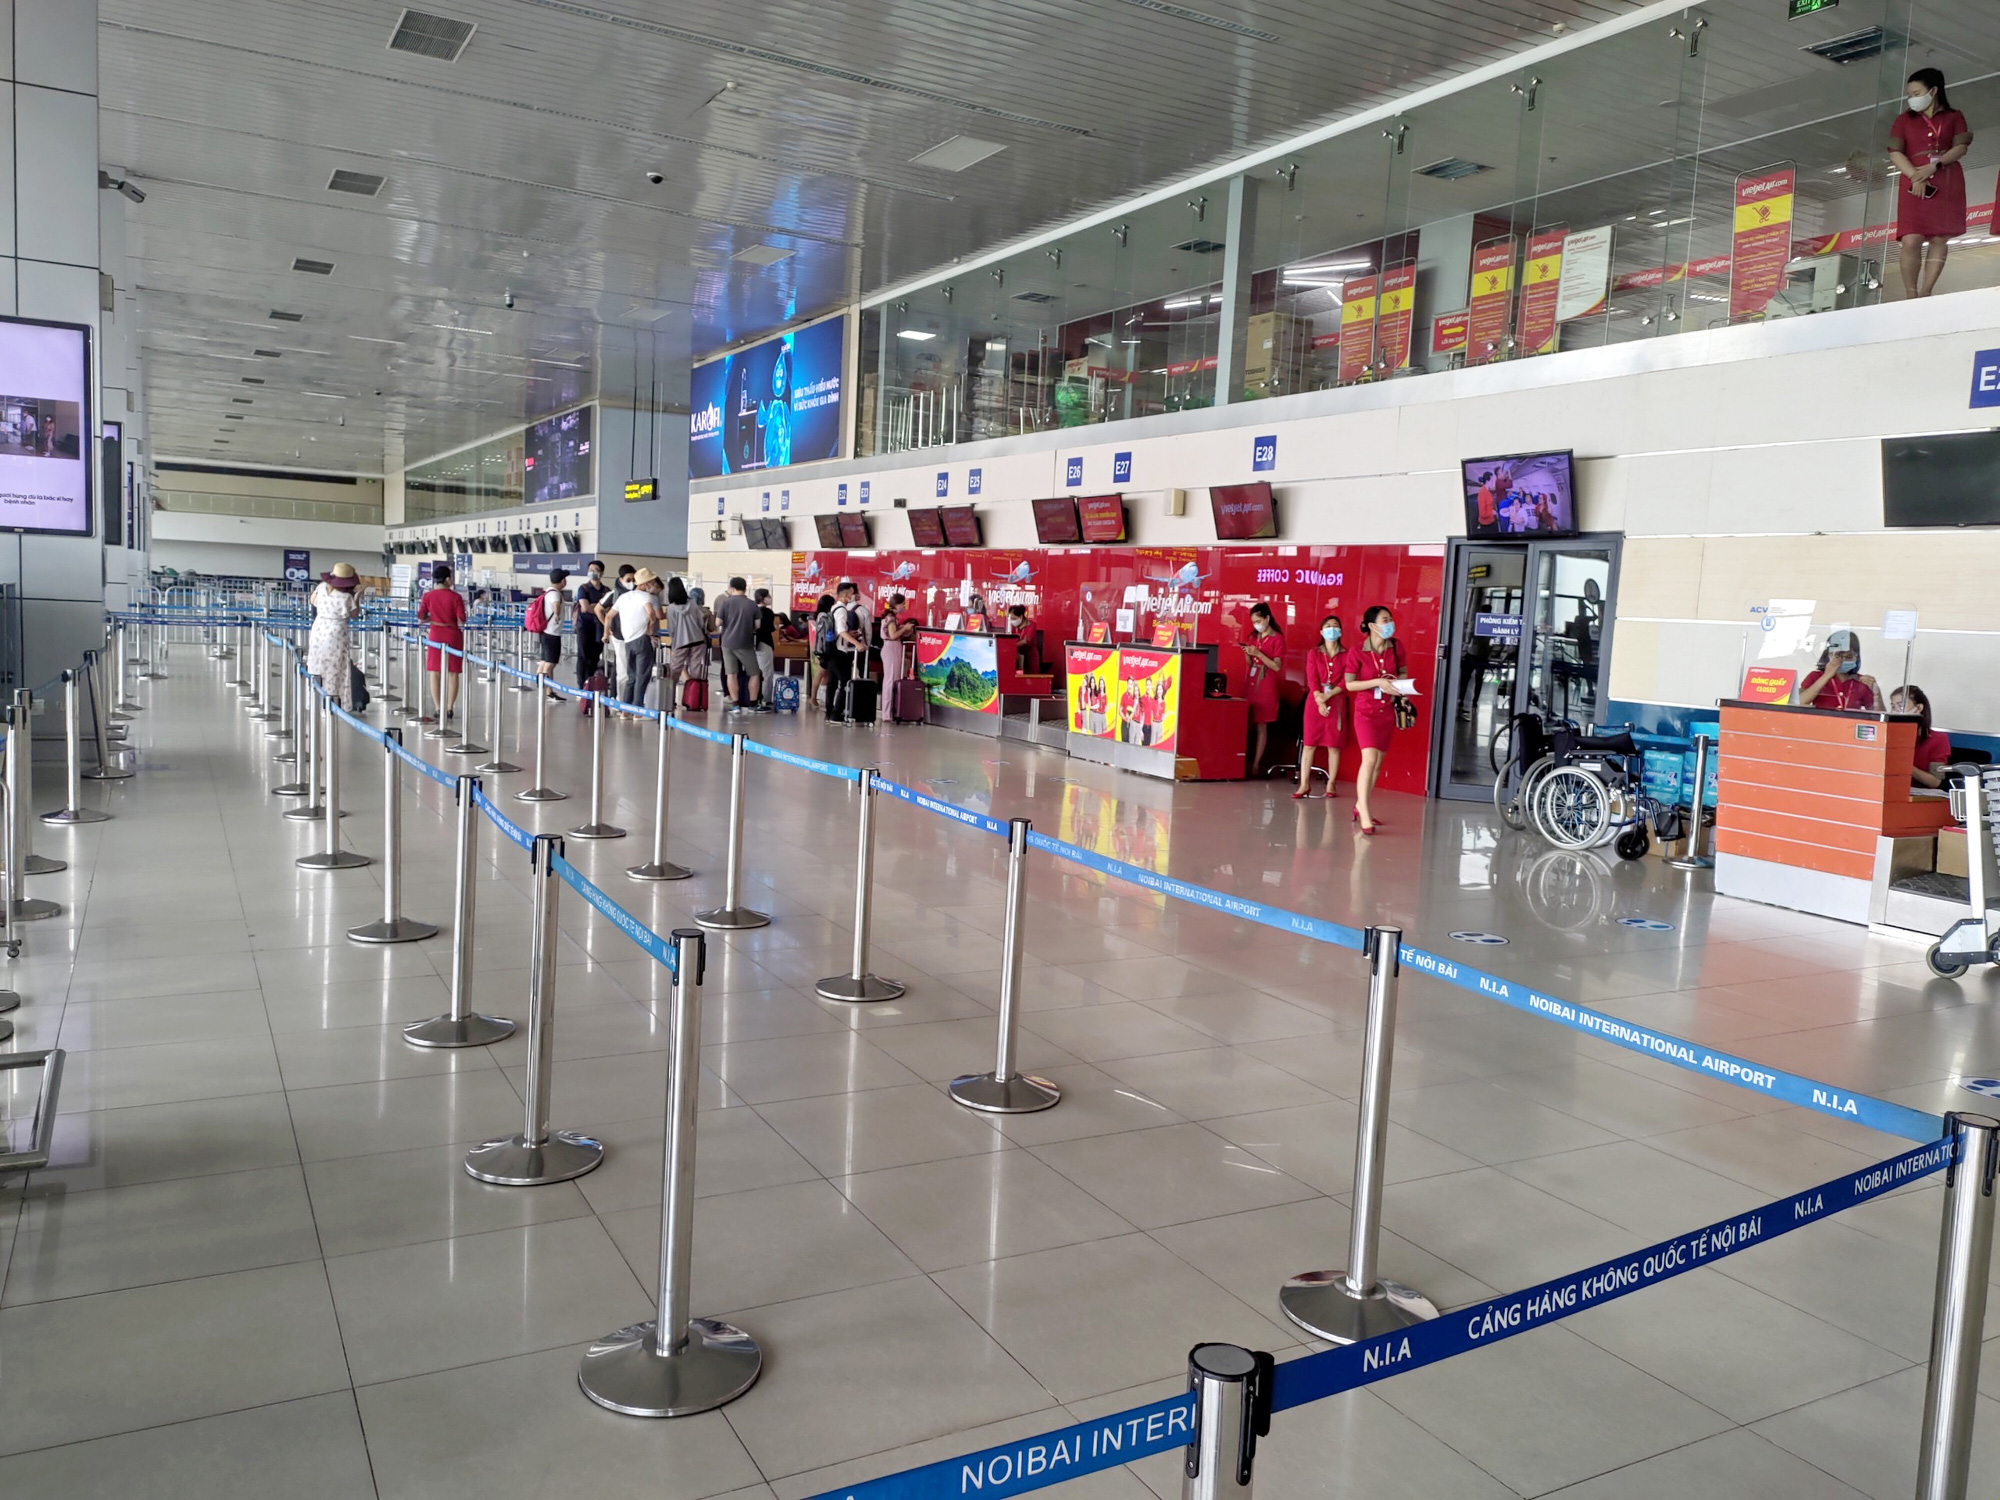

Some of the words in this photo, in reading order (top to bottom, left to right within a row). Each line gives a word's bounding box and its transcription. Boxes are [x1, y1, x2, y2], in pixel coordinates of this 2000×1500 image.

[1256, 446, 1274, 462] E28
[1068, 465, 1081, 479] E26
[1115, 460, 1130, 475] E27
[937, 479, 947, 491] E24
[969, 476, 980, 488] E25
[930, 800, 960, 819] INTERNATIONAL
[960, 811, 978, 825] AIRPORT
[1138, 874, 1162, 889] NOIBAI
[1163, 881, 1224, 907] INTERNATIONAL
[1225, 899, 1261, 918] AIRPORT
[1292, 917, 1313, 932] N.I.A
[1400, 949, 1415, 963] TẾ
[1415, 955, 1436, 972] NỘI
[1438, 963, 1457, 979] BÀI
[1480, 977, 1509, 997] N.I.A
[1529, 994, 1575, 1021] NOIBAI
[1578, 1012, 1698, 1064] INTERNATIONAL
[1702, 1055, 1776, 1089] AIRPORT
[1812, 1089, 1858, 1115] N.I.A
[1362, 1336, 1413, 1373] N.I.A
[1467, 1303, 1521, 1340] CẢNG
[1526, 1284, 1576, 1322] HÀNG
[1581, 1262, 1639, 1302] KHÔNG
[1643, 1240, 1687, 1279] QUỐC
[1690, 1227, 1710, 1261] TẾ
[1711, 1222, 1736, 1255] NỘI
[1739, 1215, 1762, 1244] BÀI
[1794, 1193, 1824, 1221] N.I.A
[1854, 1165, 1893, 1196] NOIBAI
[960, 1435, 1081, 1494] NOIBAI
